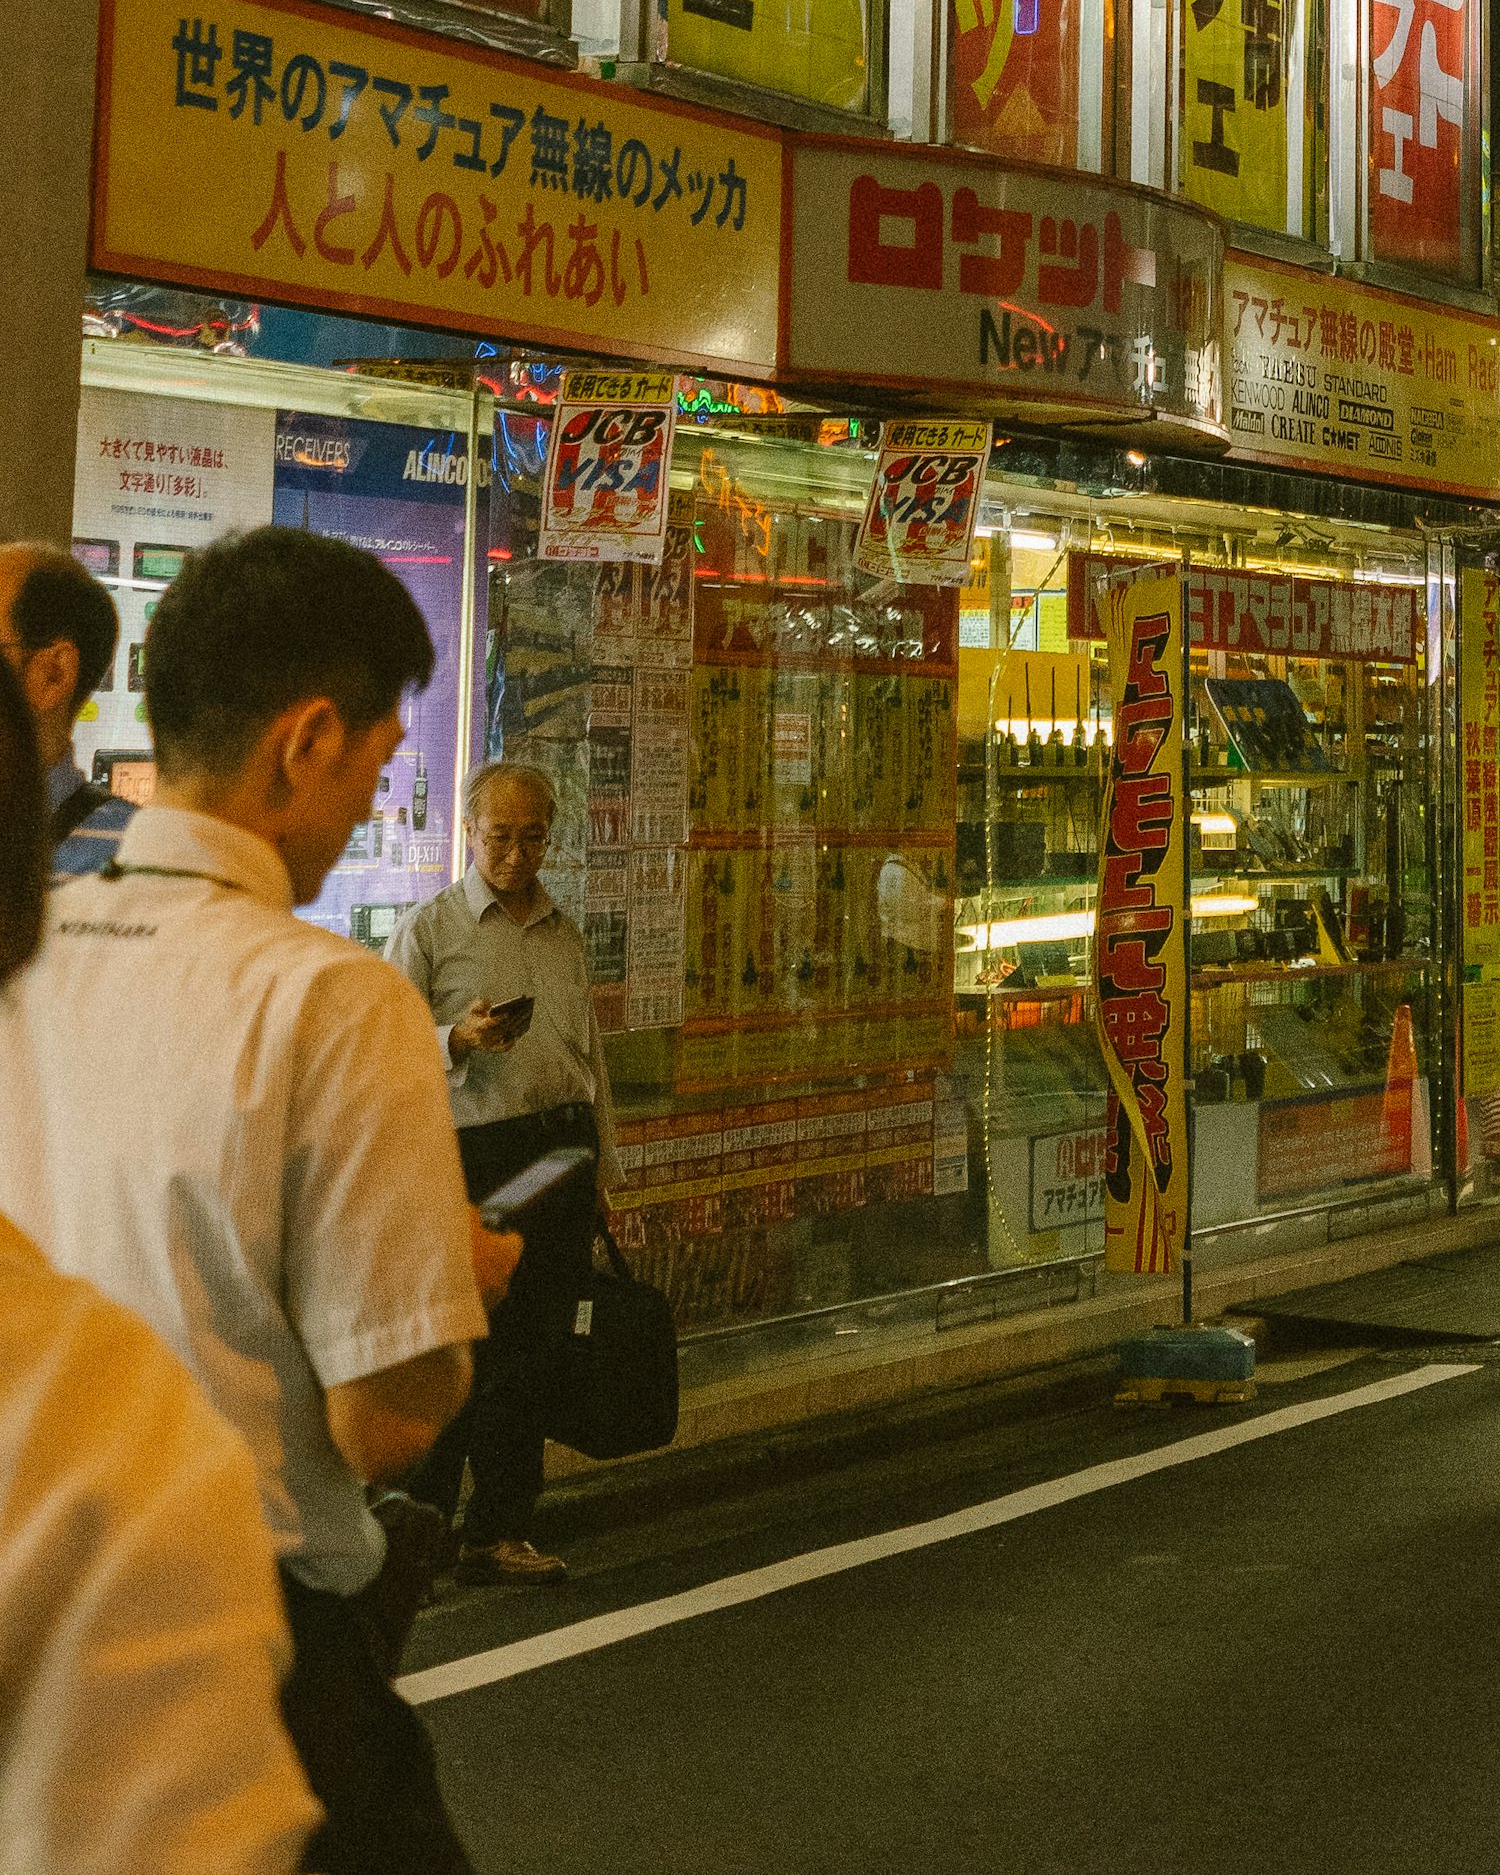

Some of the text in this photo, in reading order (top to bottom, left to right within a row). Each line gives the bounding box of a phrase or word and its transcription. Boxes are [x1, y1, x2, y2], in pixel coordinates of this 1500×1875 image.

[171, 18, 747, 232] 世界のアマチュア無線のメッカ
[252, 150, 650, 309] 人と人のふれあい
[568, 375, 634, 400] 使用できる
[1231, 378, 1394, 429] KENWOOD ALINCO DIAMOND
[1323, 374, 1388, 404] STANDARD
[560, 409, 667, 446] JCB
[1271, 414, 1316, 445] CREATE
[402, 449, 468, 486] ALINCO
[557, 457, 661, 493] VISA
[885, 455, 979, 485] JCB
